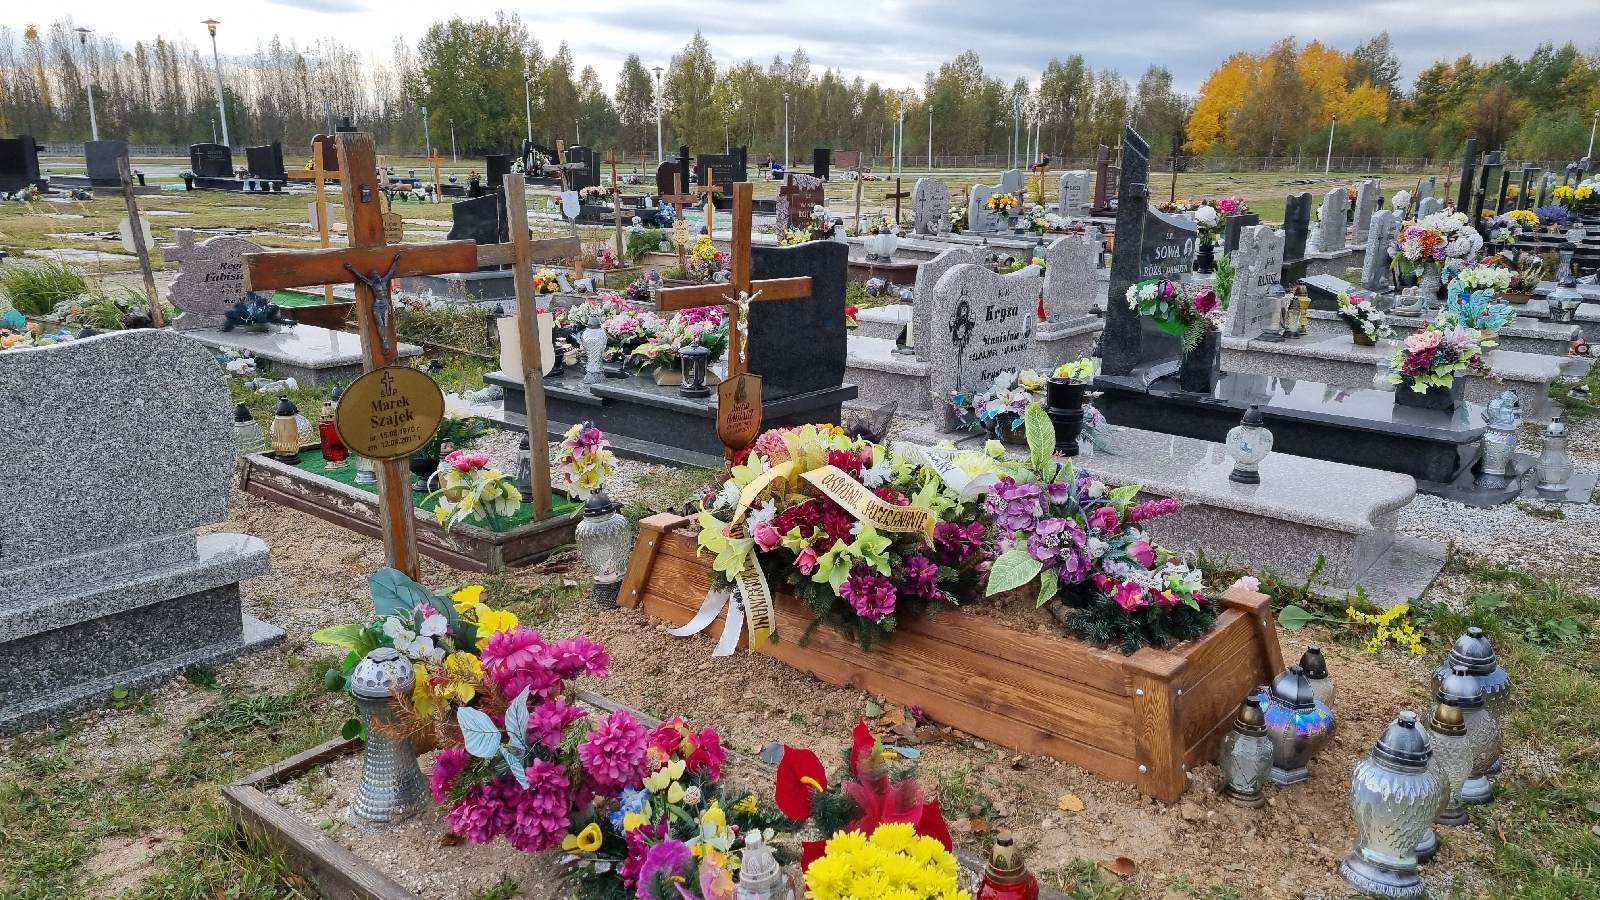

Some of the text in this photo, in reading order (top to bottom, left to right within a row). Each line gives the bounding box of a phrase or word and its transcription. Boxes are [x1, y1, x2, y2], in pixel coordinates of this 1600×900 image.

[1154, 245, 1181, 260] SOWA
[219, 262, 242, 271] Regi
[371, 396, 410, 413] Marek
[371, 409, 414, 429] Szajek
